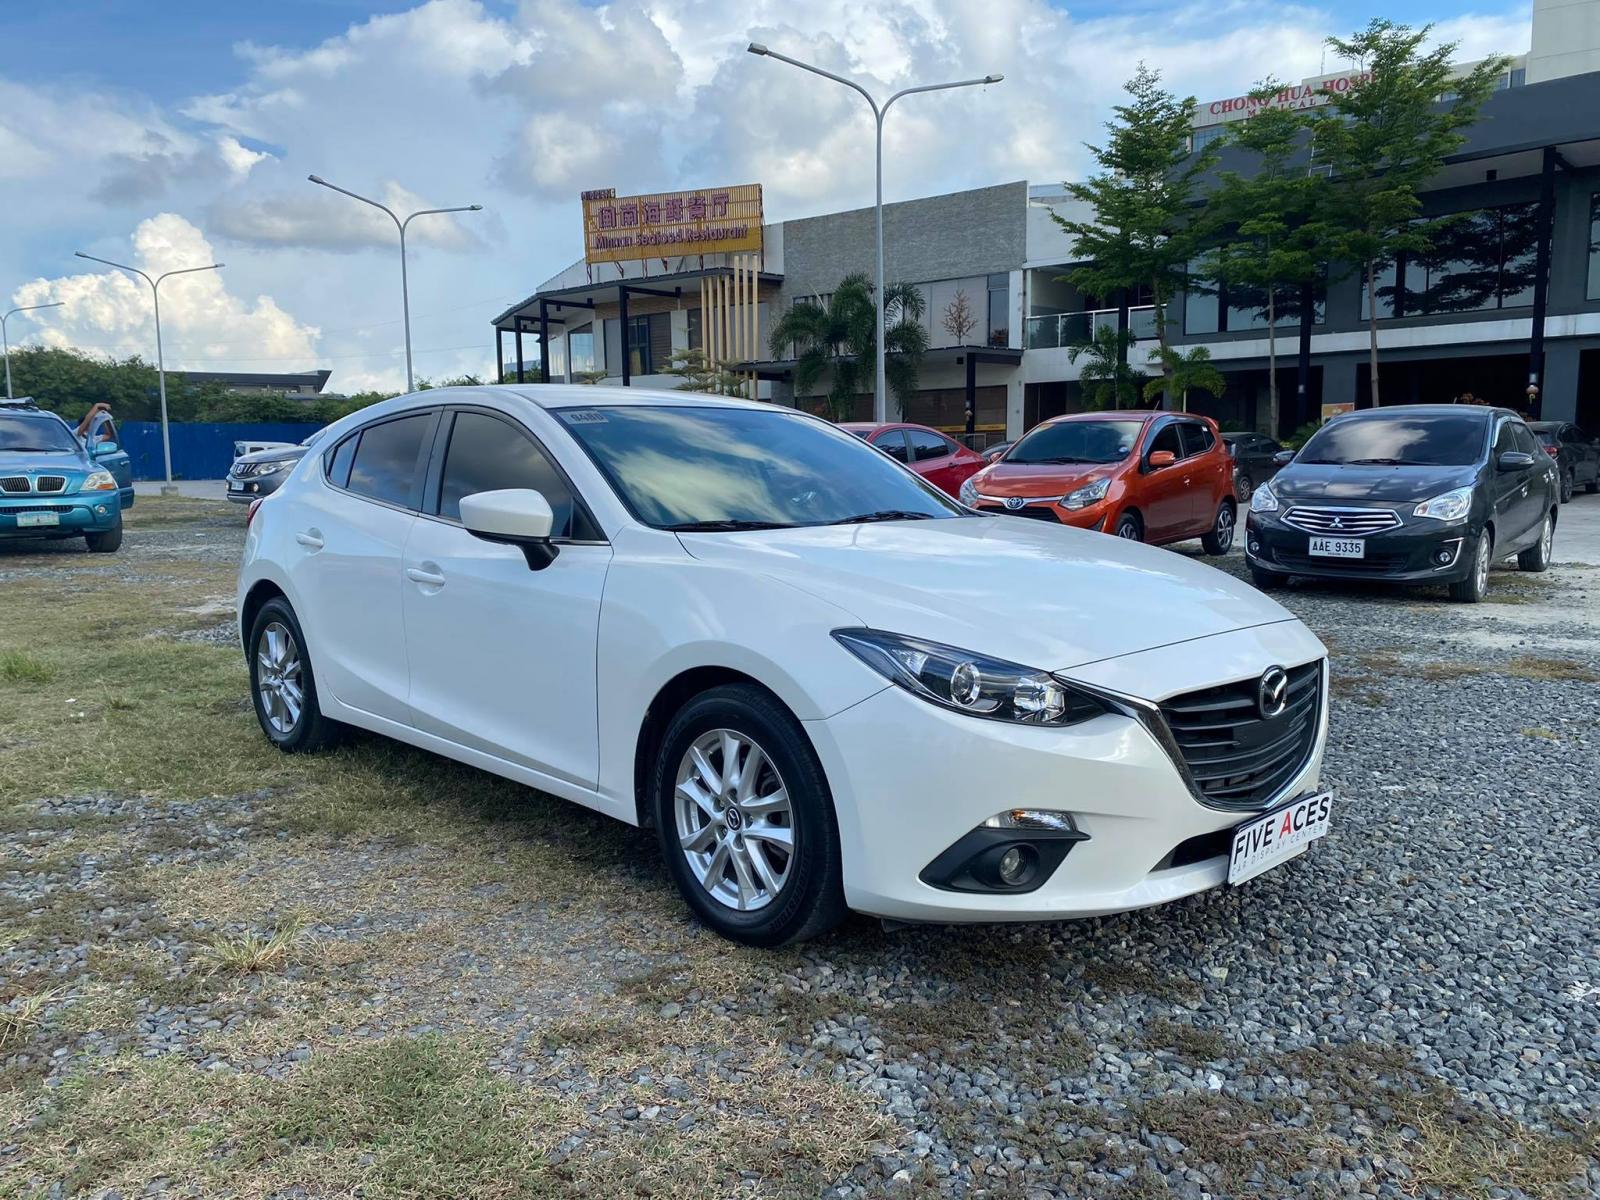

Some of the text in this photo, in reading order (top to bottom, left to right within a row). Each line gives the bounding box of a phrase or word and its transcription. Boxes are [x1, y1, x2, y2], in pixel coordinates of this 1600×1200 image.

[1277, 85, 1313, 103] HUA
[1247, 98, 1316, 118] MICAL
[636, 229, 683, 246] Seafood
[685, 225, 748, 243] Restaurant
[1312, 541, 1361, 553] AAE 9335
[1234, 796, 1330, 865] FIVE ACES
[1290, 823, 1324, 844] CENTER
